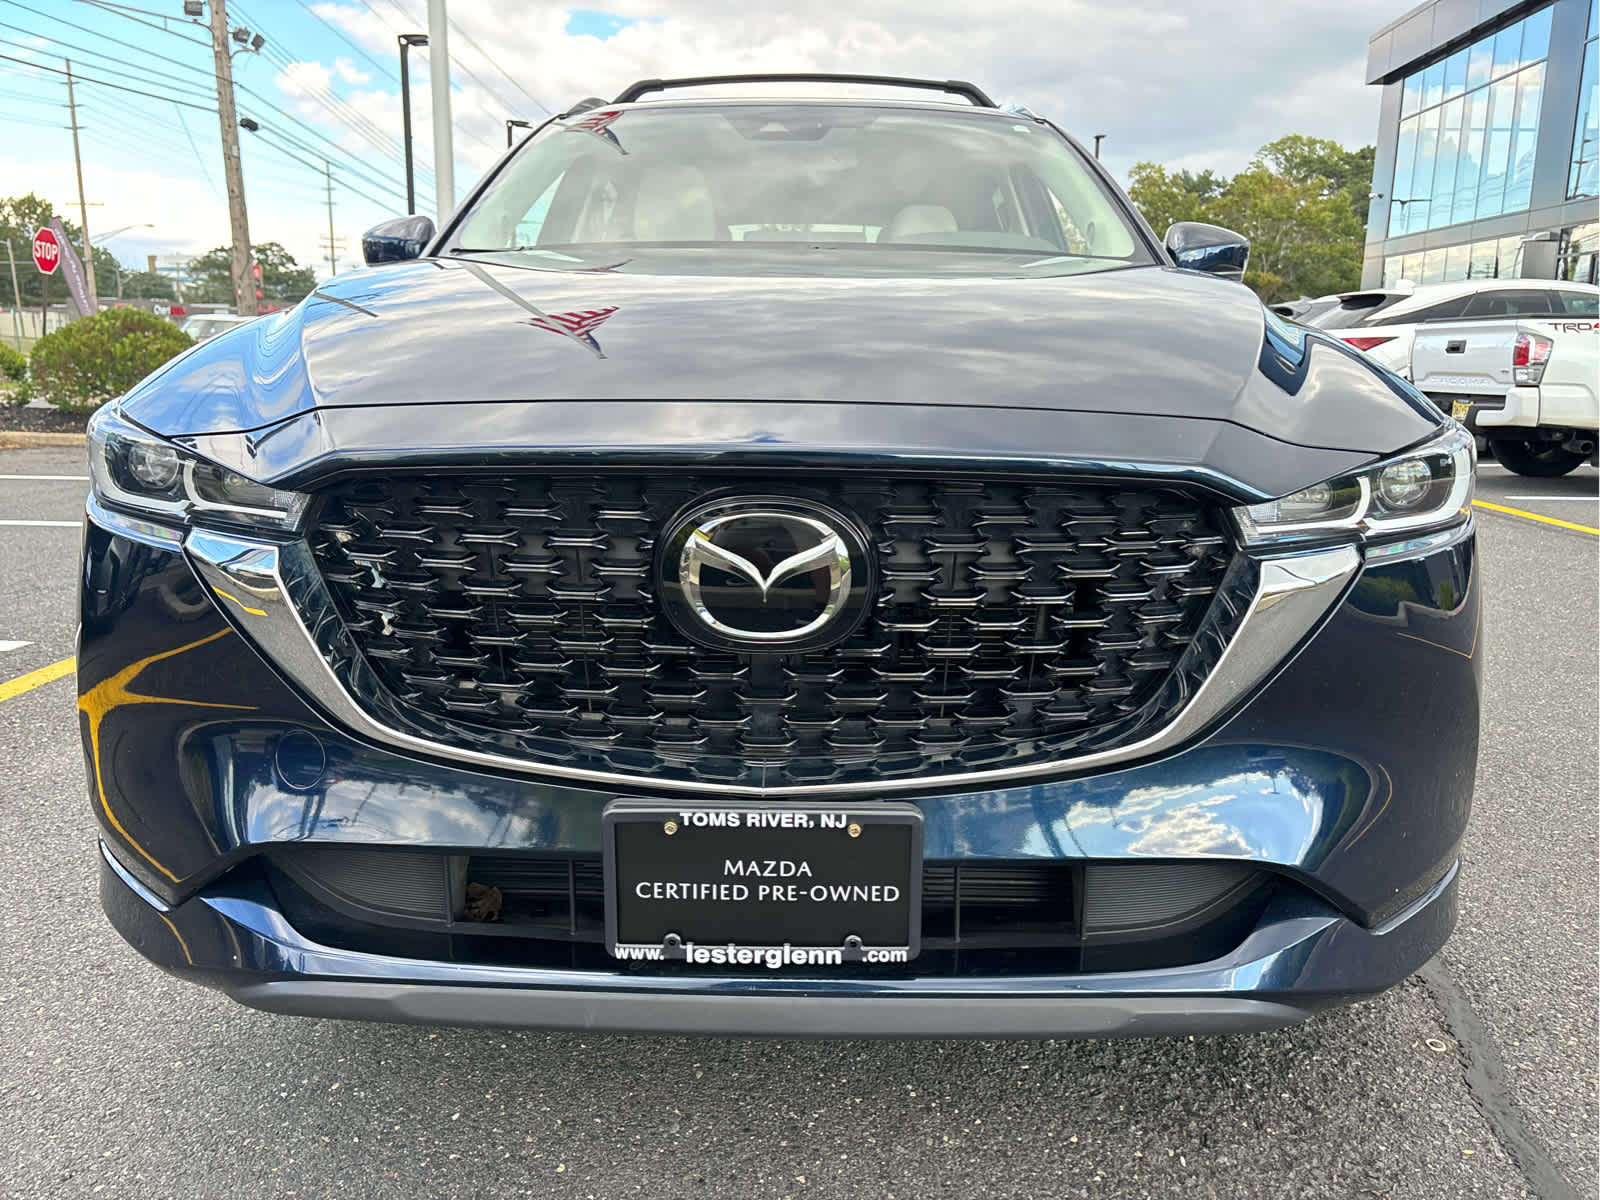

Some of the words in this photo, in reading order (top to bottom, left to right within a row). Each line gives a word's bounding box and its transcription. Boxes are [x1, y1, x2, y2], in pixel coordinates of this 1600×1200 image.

[34, 240, 58, 260] STOP
[680, 812, 740, 827] TOMS
[747, 813, 814, 828] RIVER,
[820, 814, 847, 828] NJ
[723, 860, 812, 877] MAZDA
[635, 882, 749, 901] CERTIFIED
[758, 884, 900, 902] PRE-OWNED
[615, 947, 665, 960] www.
[686, 942, 842, 969] lesterglenn
[862, 949, 908, 962] .com
